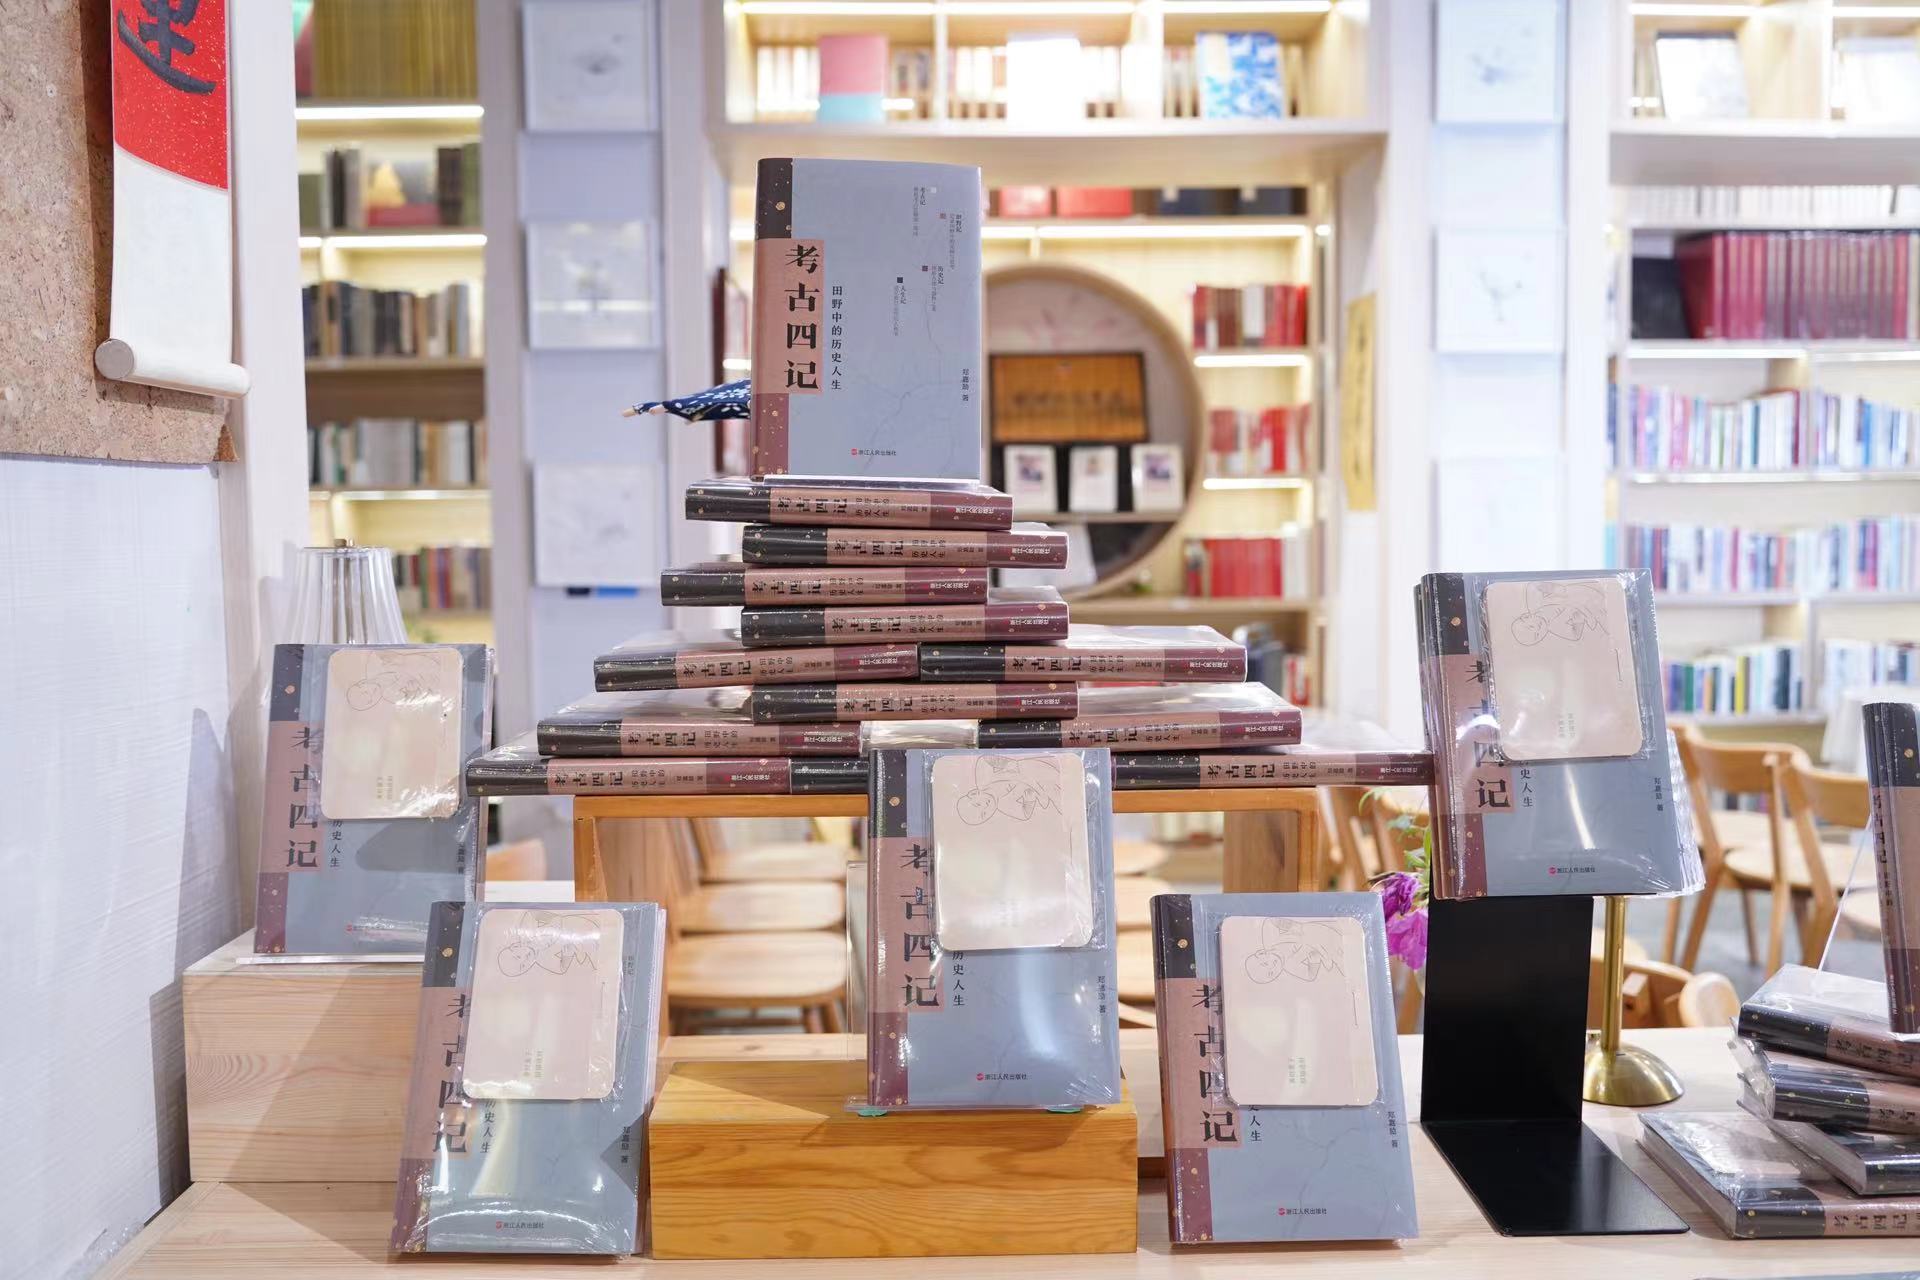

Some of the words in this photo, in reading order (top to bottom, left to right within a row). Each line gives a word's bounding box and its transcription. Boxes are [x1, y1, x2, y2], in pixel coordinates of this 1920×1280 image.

[784, 244, 820, 390] 考古四记
[831, 285, 843, 390] 田野中的历史人生
[777, 497, 847, 514] 考古四记
[834, 540, 904, 557] 考古四记
[752, 578, 822, 595] 考古四记
[831, 616, 902, 633] 考古四记
[683, 660, 751, 679] 考古四记
[1011, 656, 1081, 672] 考古四记
[843, 696, 913, 713] 考古四记
[627, 731, 696, 747] 考古四记
[1068, 726, 1138, 743] 考古四记
[554, 771, 624, 787] 考古四记
[1206, 763, 1275, 779] 考古四记
[1557, 866, 1596, 874] 浙江人民出版社
[901, 844, 939, 1007] 考古四记
[984, 1072, 1028, 1081] 浙江人民出版社
[1286, 1207, 1327, 1215] 浙江人民出版社
[503, 1221, 545, 1229] 浙江人民出版社
